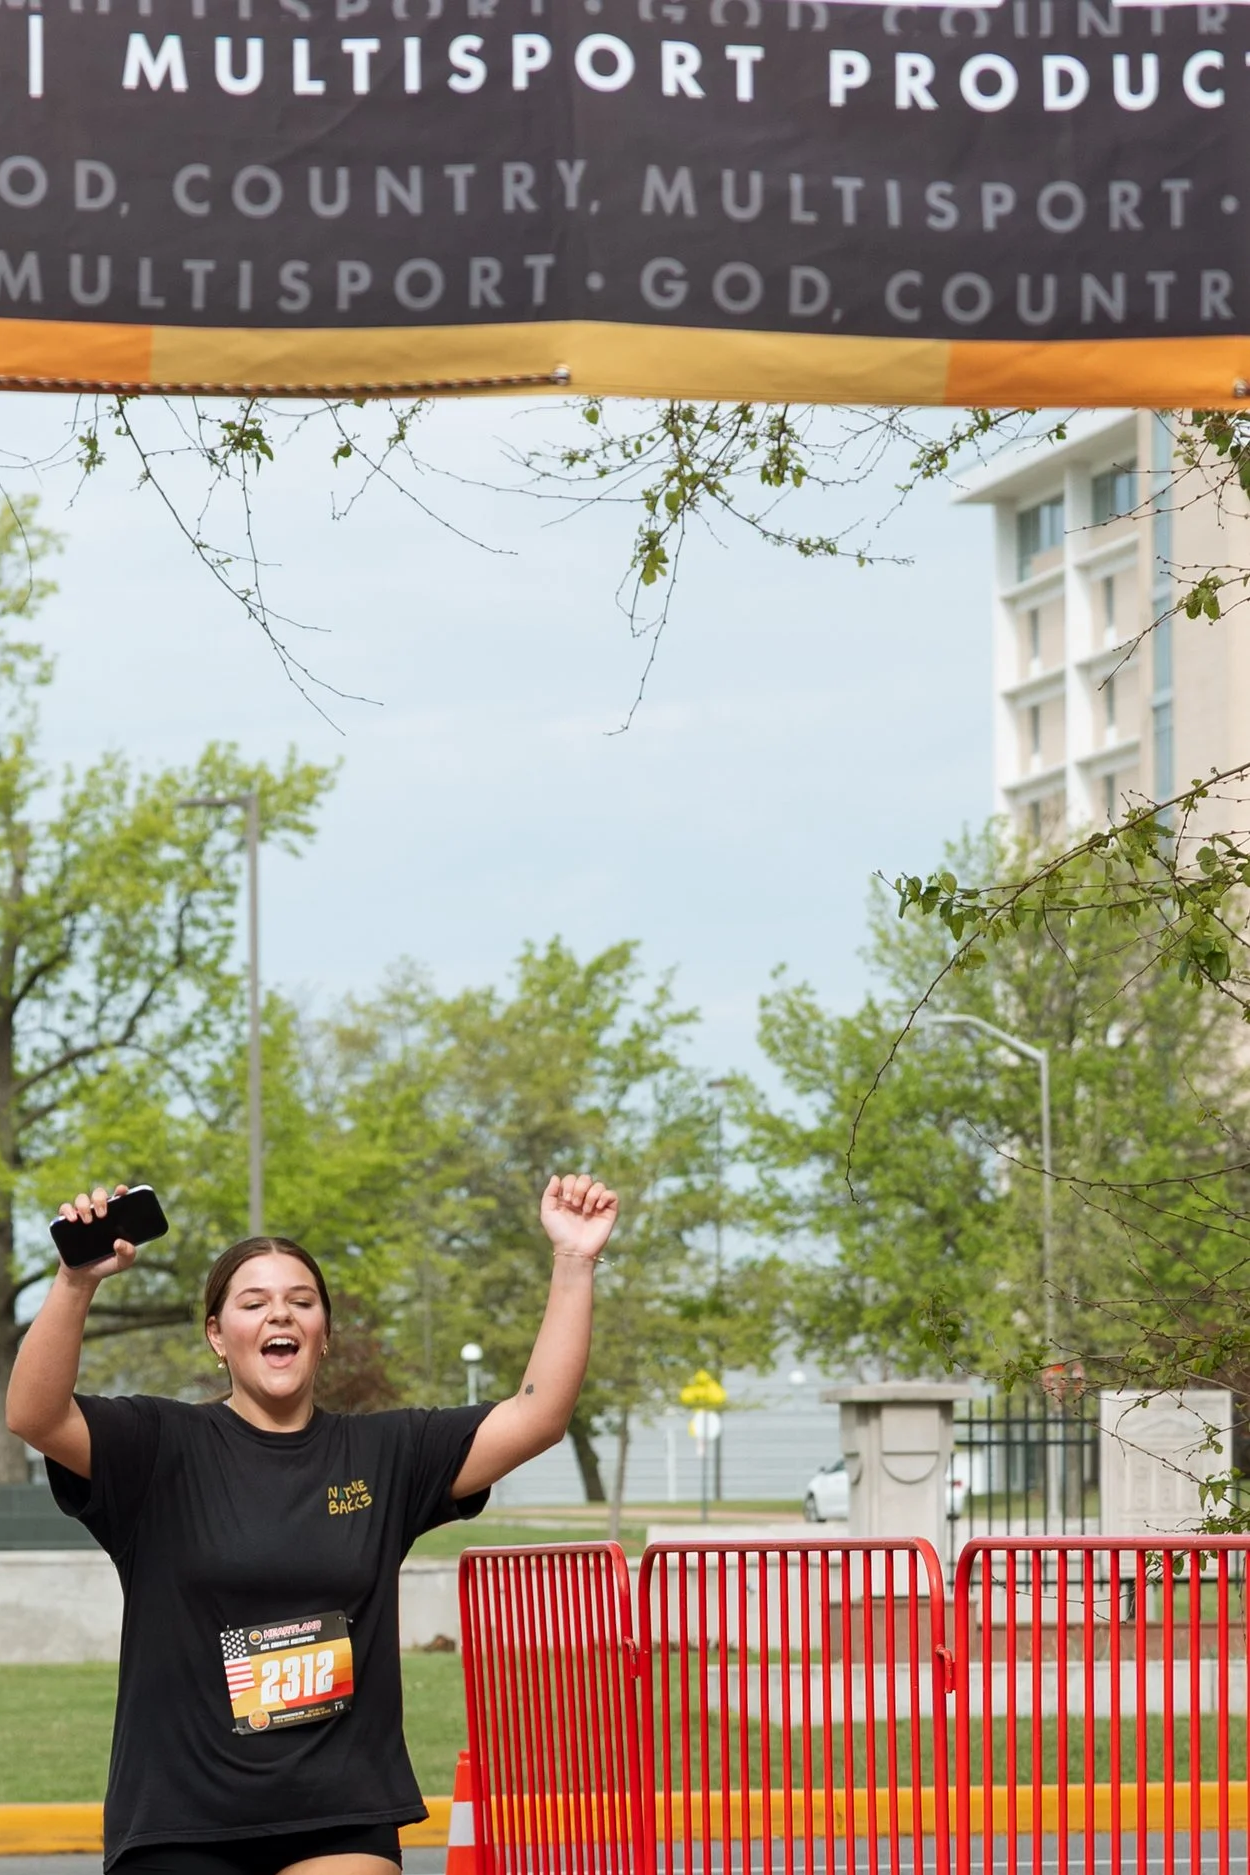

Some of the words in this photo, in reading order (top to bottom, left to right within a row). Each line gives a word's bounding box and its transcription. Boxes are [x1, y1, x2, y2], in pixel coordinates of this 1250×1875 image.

[122, 33, 765, 102] MULTISPORT
[829, 49, 1250, 112] PRODUC
[174, 159, 598, 218] COUNTRY,
[641, 165, 1192, 233] MULTISPORT
[640, 257, 841, 319] GOD,
[885, 268, 1236, 325] COUNTR
[260, 1650, 335, 1706] 2312
